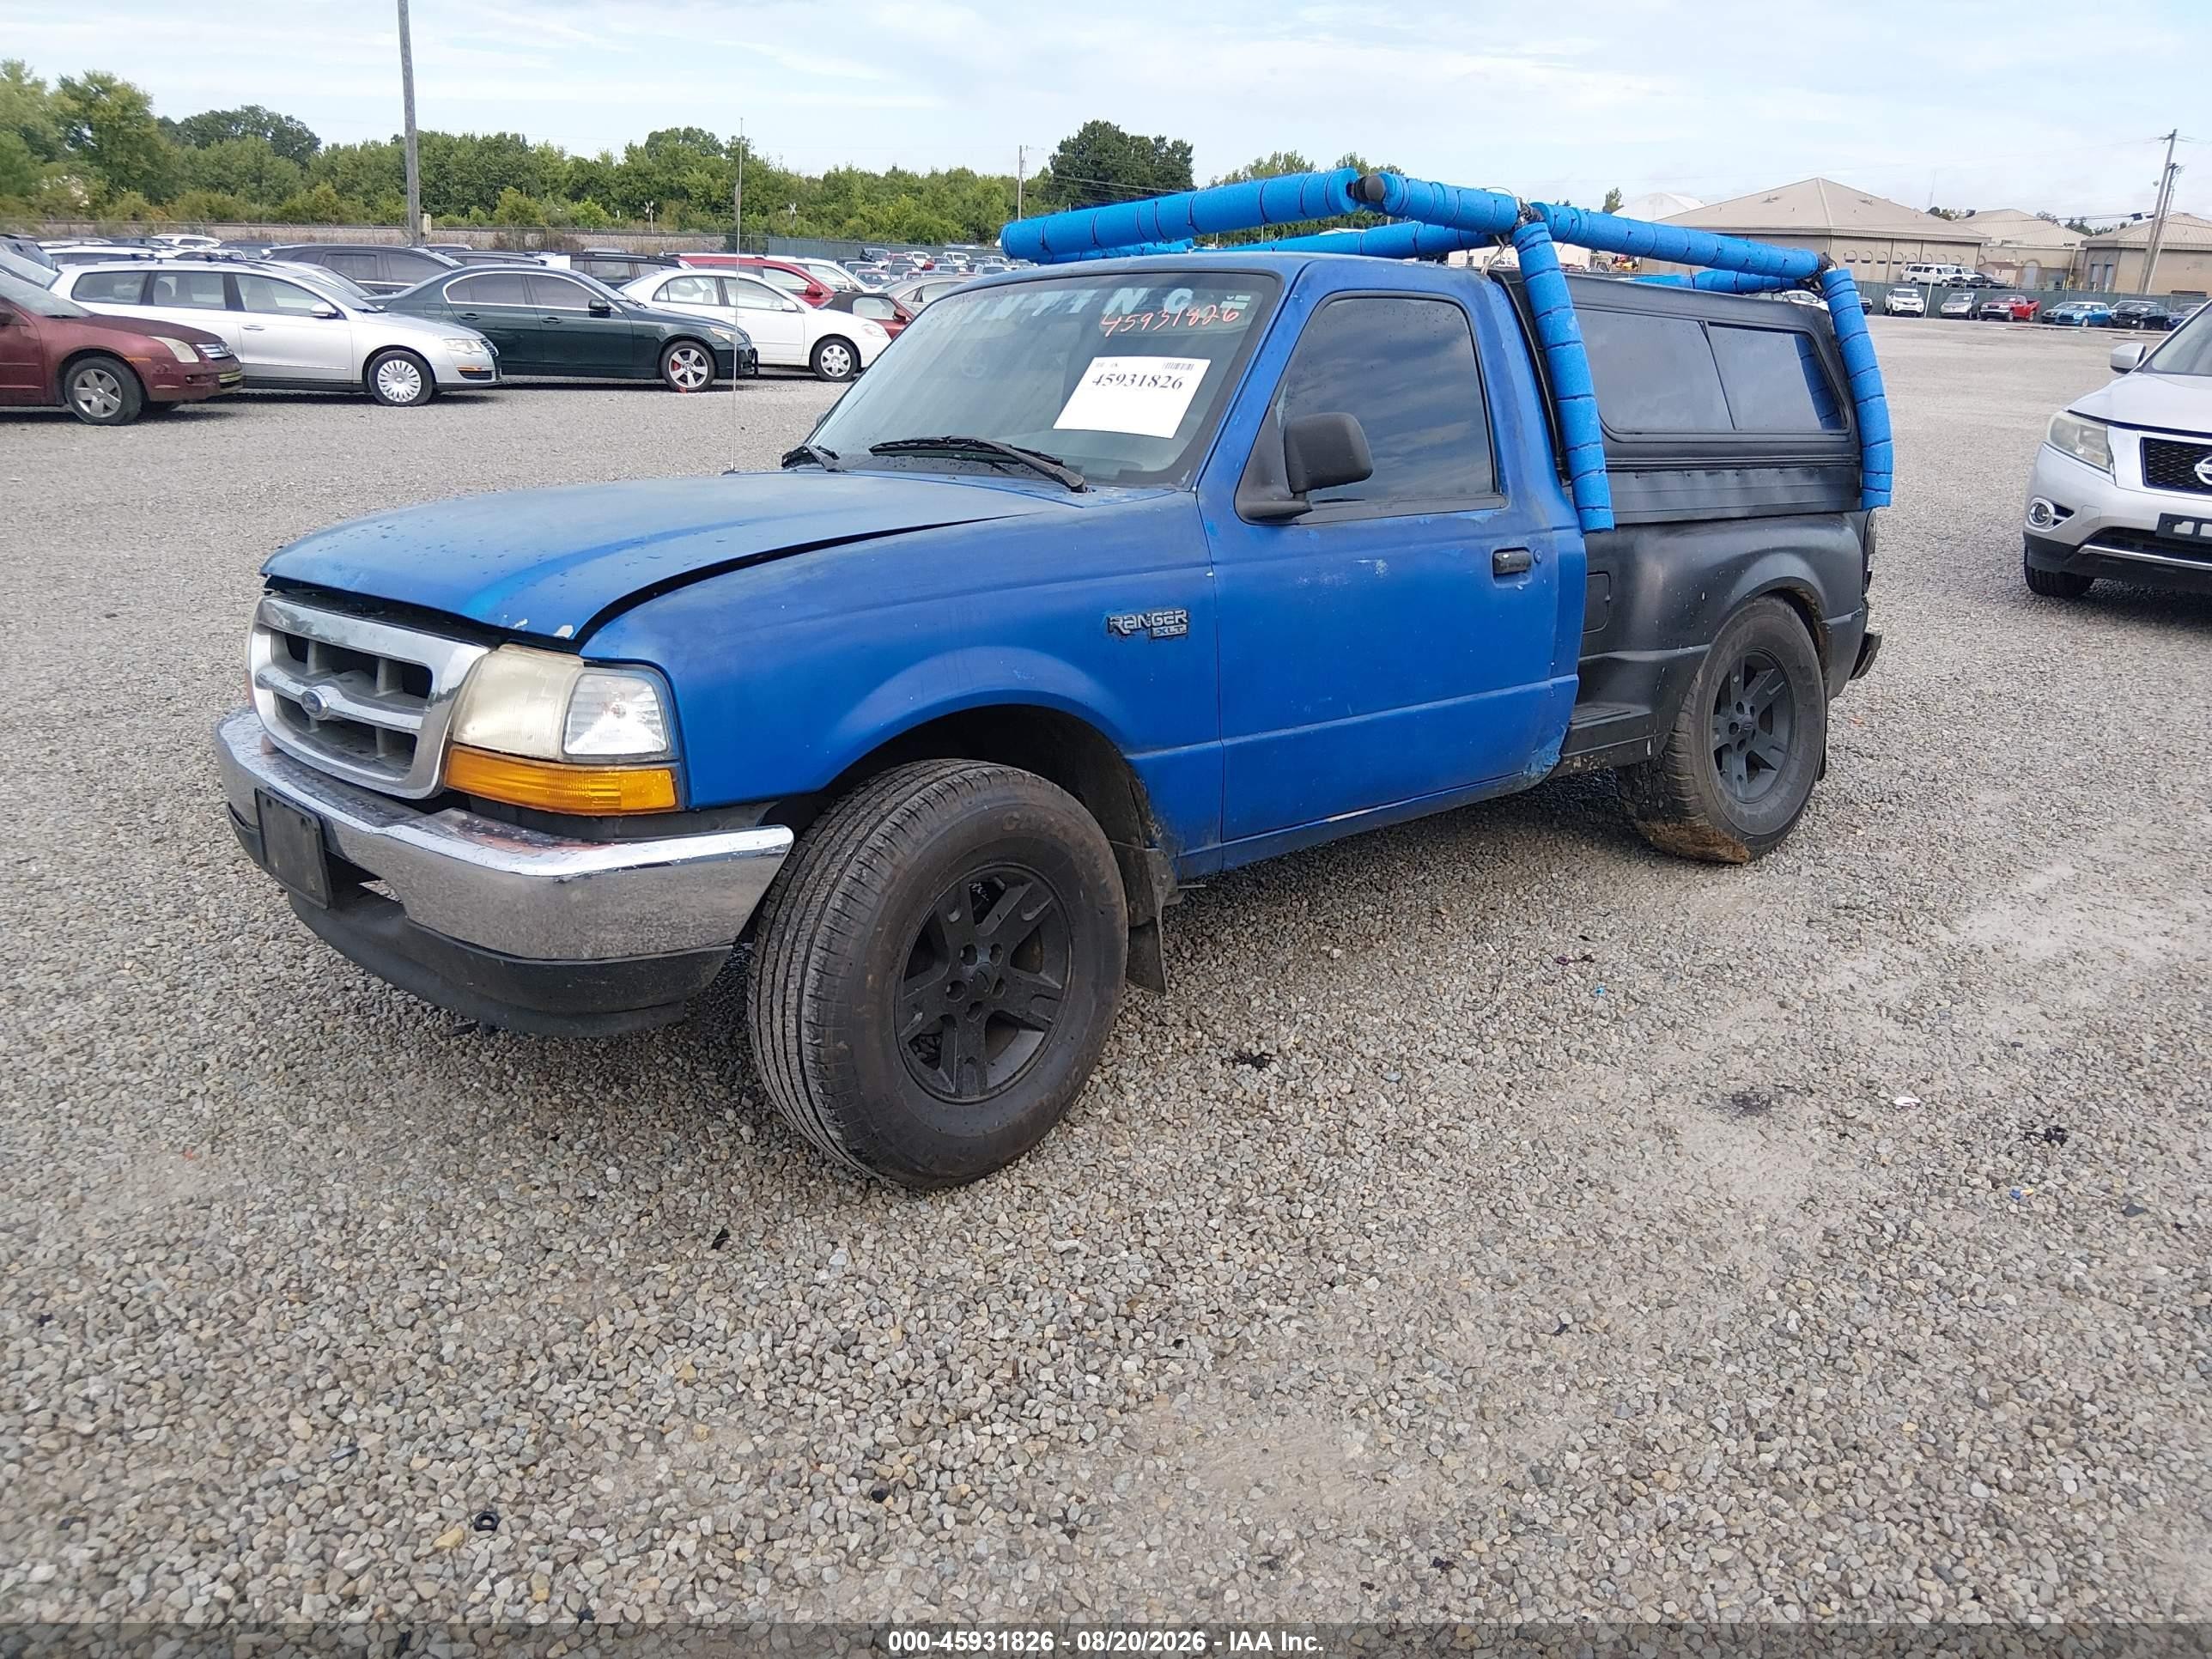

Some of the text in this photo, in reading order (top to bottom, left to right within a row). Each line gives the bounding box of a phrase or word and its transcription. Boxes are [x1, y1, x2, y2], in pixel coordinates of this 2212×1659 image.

[1100, 304, 1240, 337] 45931826
[1091, 373, 1184, 391] 45931826
[1108, 609, 1188, 635] RANGER
